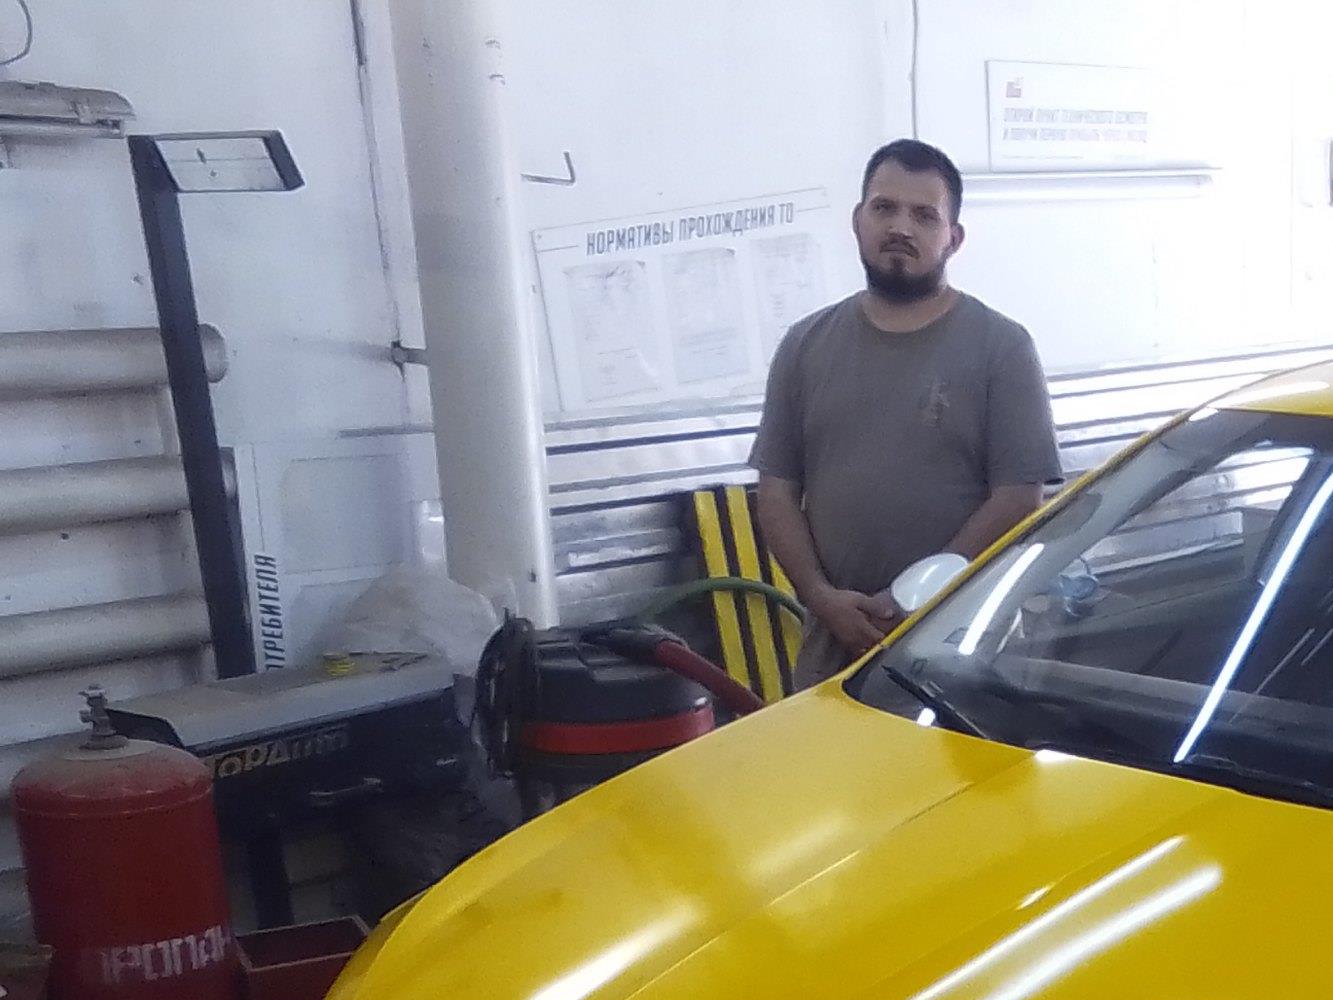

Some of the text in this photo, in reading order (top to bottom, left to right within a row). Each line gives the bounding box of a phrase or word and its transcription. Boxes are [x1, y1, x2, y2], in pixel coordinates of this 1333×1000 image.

[585, 202, 795, 256] НОРМАТИВЫ ПРОХОЖДЕНИЯ ТО
